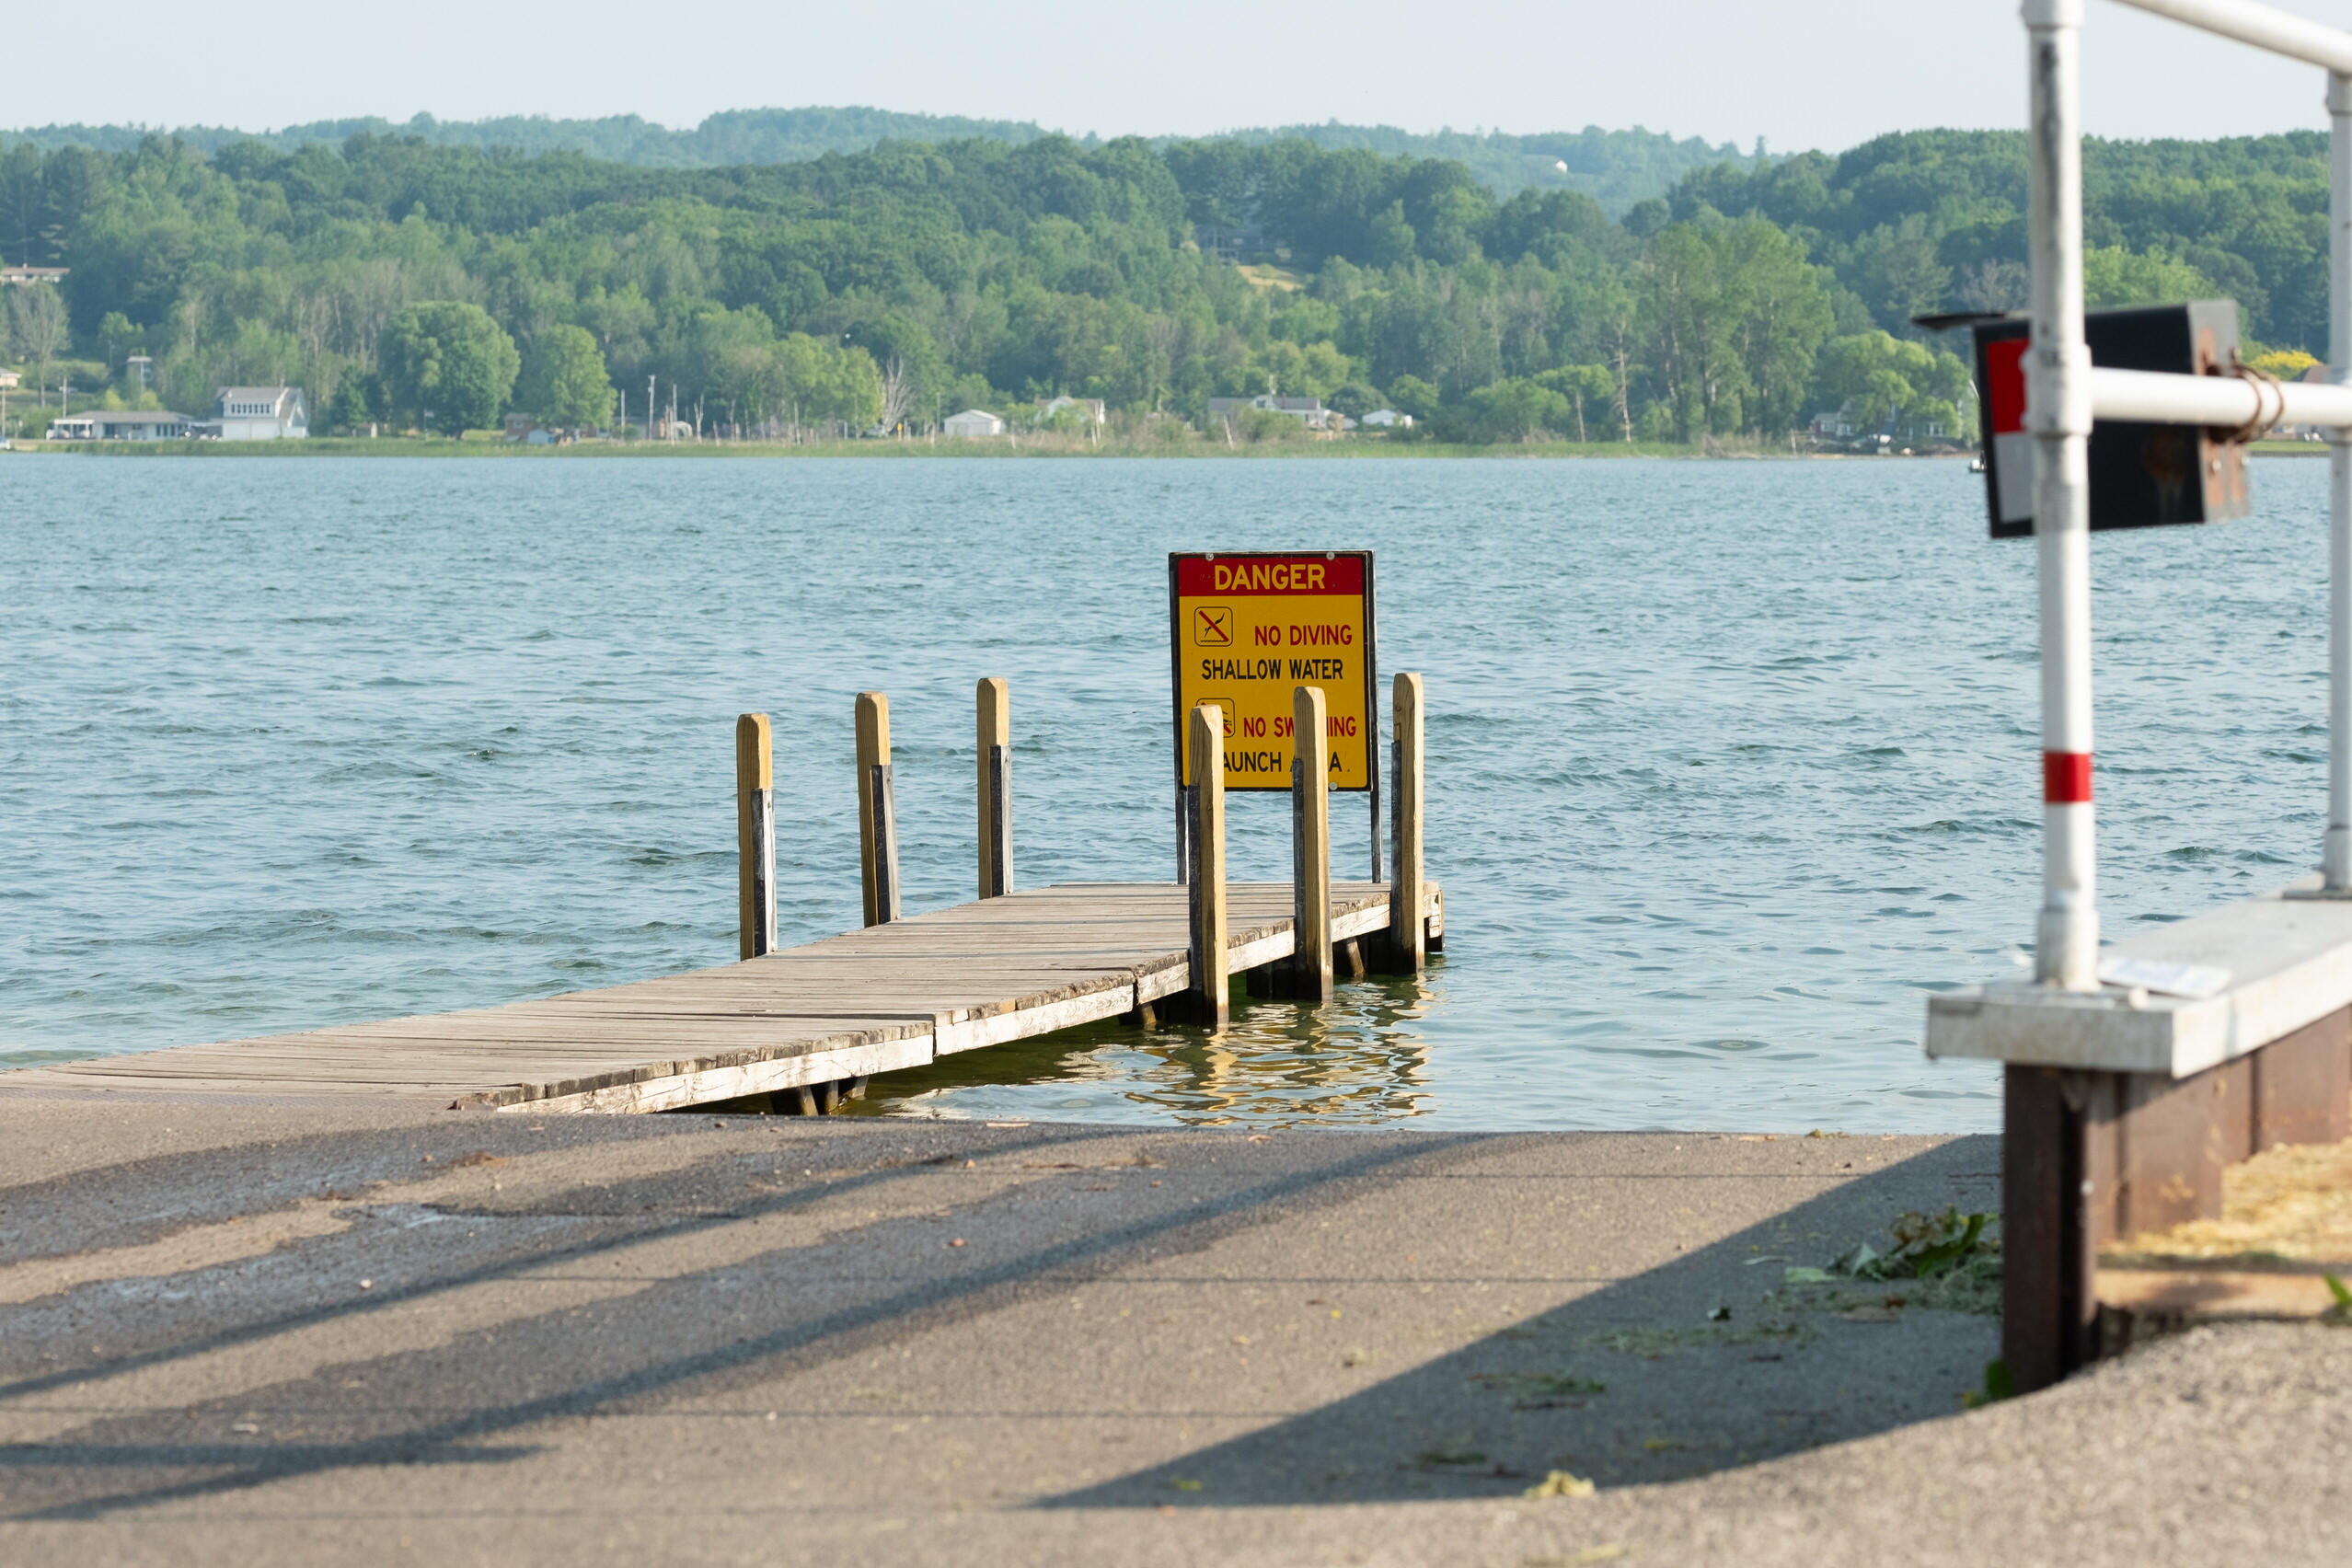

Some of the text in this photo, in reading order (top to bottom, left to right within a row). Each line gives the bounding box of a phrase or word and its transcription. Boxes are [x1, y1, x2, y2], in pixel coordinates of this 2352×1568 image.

[1214, 563, 1326, 591] DANGER
[1254, 624, 1353, 646] NO DIVING
[1201, 659, 1343, 680] SHALLOW WATER
[1243, 716, 1356, 738] NO SWING
[1223, 751, 1282, 773] AUNCH
